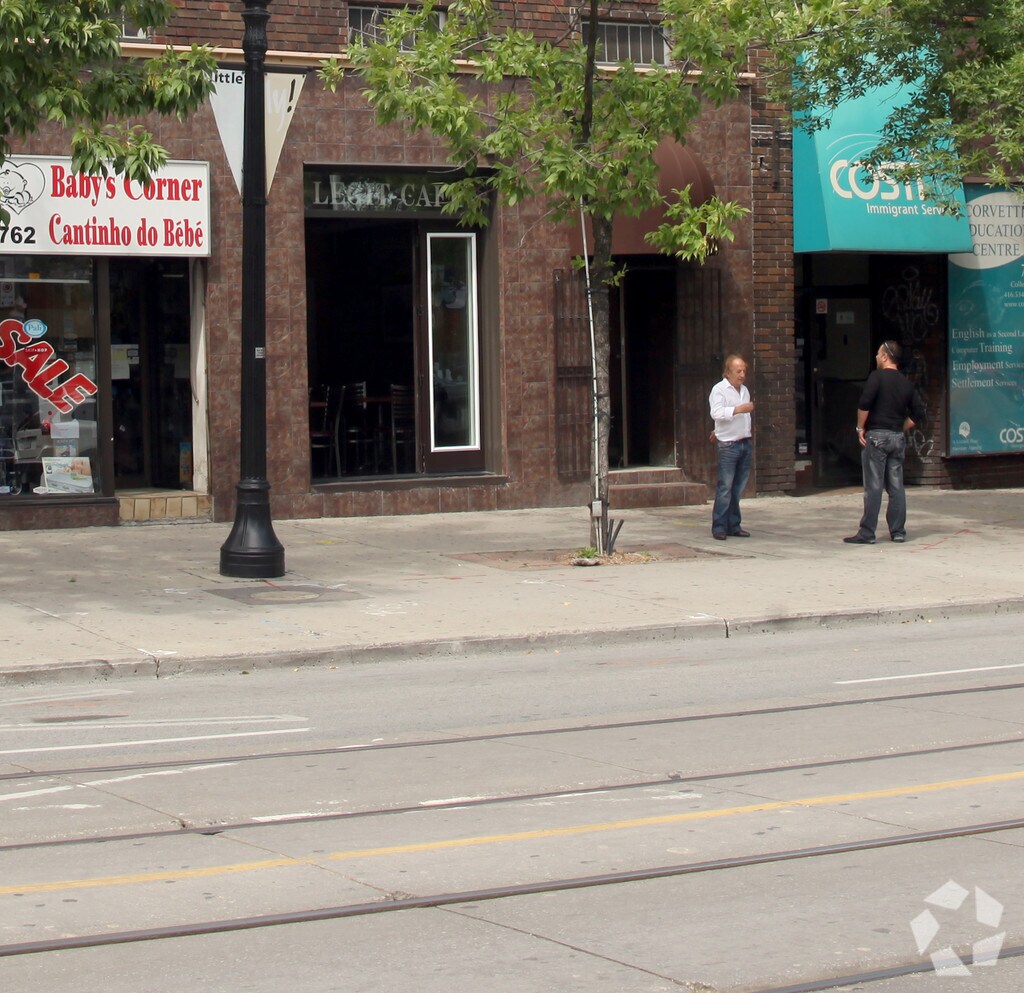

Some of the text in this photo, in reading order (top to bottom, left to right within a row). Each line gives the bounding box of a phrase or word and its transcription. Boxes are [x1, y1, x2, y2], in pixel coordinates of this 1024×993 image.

[212, 71, 243, 85] ittle
[50, 164, 116, 207] Babys
[401, 182, 462, 208] CAF
[866, 203, 919, 218] Immigrant
[0, 226, 36, 244] 762
[48, 212, 204, 248] Cantinho do Bébé
[969, 223, 1024, 237] DUCATIO
[972, 242, 1021, 257] CENTRE
[28, 323, 43, 332] Pali
[951, 328, 985, 342] English
[997, 330, 1017, 338] Second
[979, 341, 1013, 355] Training
[952, 359, 1004, 374] Employment
[951, 377, 994, 388] Settlement
[999, 427, 1024, 444] COS
